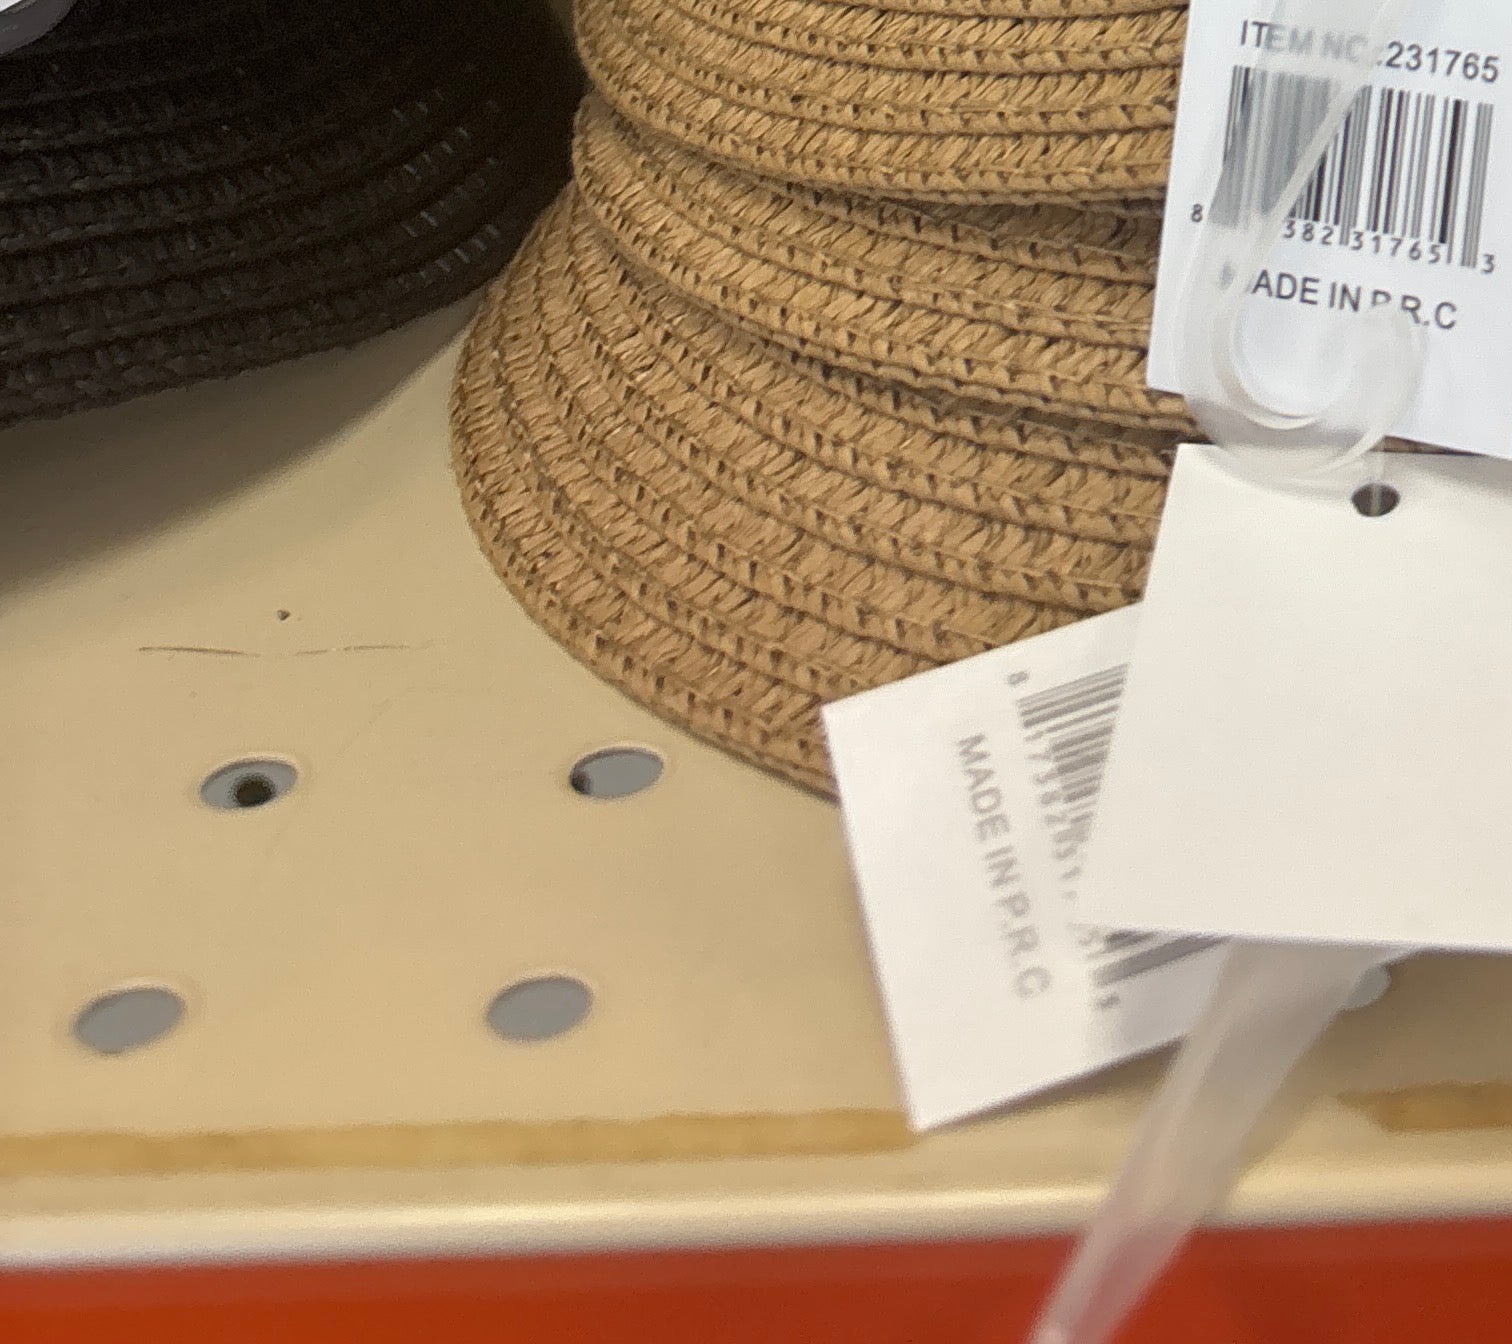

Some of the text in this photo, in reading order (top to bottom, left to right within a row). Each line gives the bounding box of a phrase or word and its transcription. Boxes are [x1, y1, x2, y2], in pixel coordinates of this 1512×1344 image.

[1239, 18, 1314, 54] ITEM
[1250, 268, 1321, 306] ADE
[1328, 280, 1362, 313] IN
[957, 732, 1011, 843] MADE
[984, 844, 1021, 889] IN
